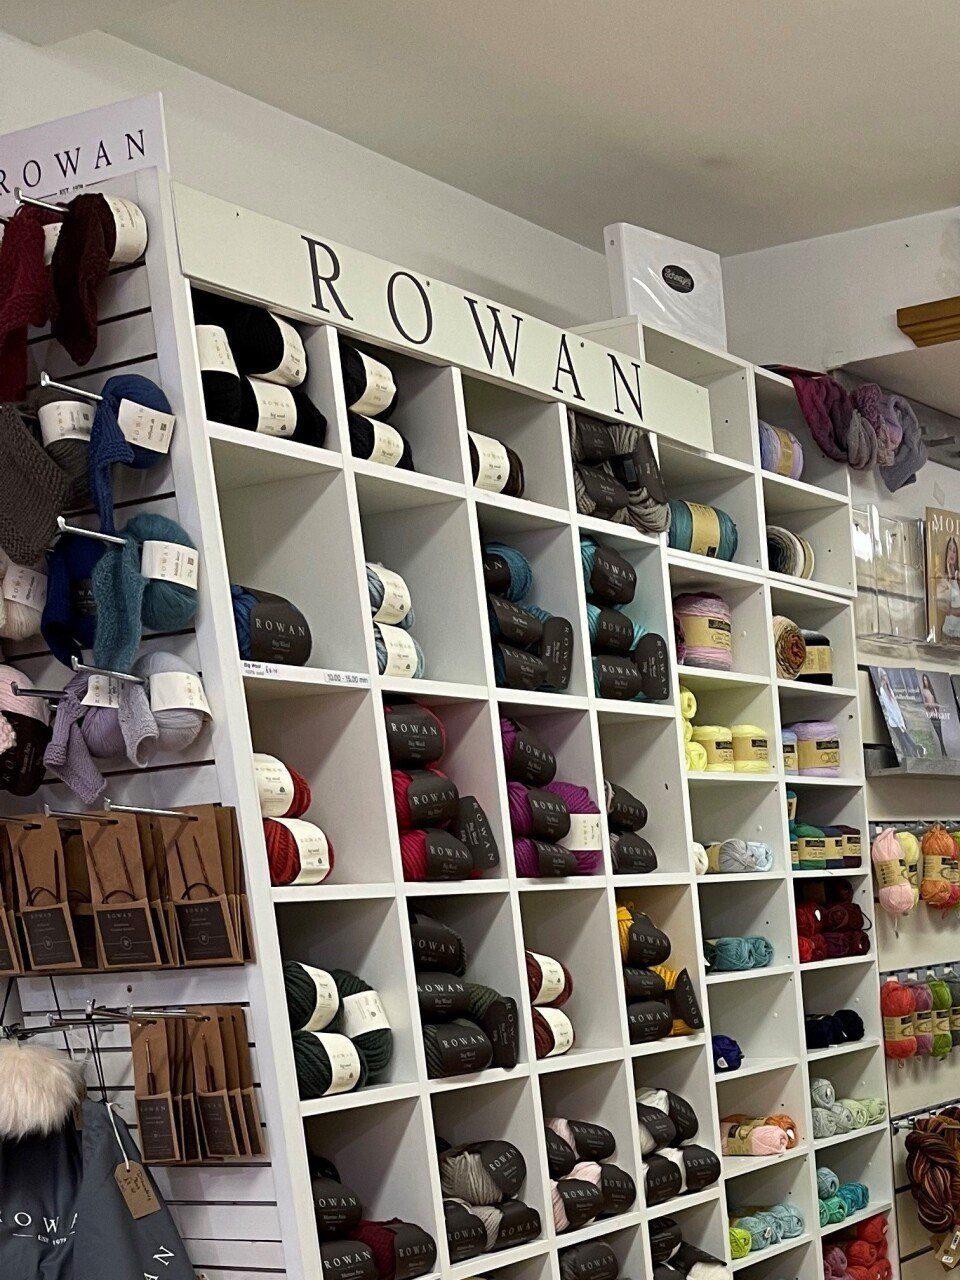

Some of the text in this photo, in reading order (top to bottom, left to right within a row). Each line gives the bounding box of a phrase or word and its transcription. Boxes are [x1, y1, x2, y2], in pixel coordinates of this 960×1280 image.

[301, 235, 643, 421] ROWAN
[255, 618, 306, 637] ROWAN
[560, 626, 570, 684] ROWAN
[601, 664, 639, 676] ROWAN
[657, 640, 667, 696] ROWAN
[391, 722, 438, 736] ROWAN
[519, 741, 554, 764] ROWAN
[414, 790, 455, 805] ROWAN
[533, 801, 567, 814] ROWAN
[473, 802, 496, 861] ROWAN
[430, 845, 469, 860] ROWAN
[632, 932, 668, 947] ROWAN
[416, 983, 464, 993] ROWAN
[630, 1012, 670, 1023] ROWAN
[442, 1034, 485, 1049] ROWAN
[489, 1150, 516, 1171] ROWAN
[563, 1188, 599, 1199] ROWAN
[314, 1197, 357, 1208] OWAN
[501, 1219, 539, 1238] ROWAN
[398, 1243, 434, 1258] ROWAN
[324, 1250, 371, 1270] ROWAN
